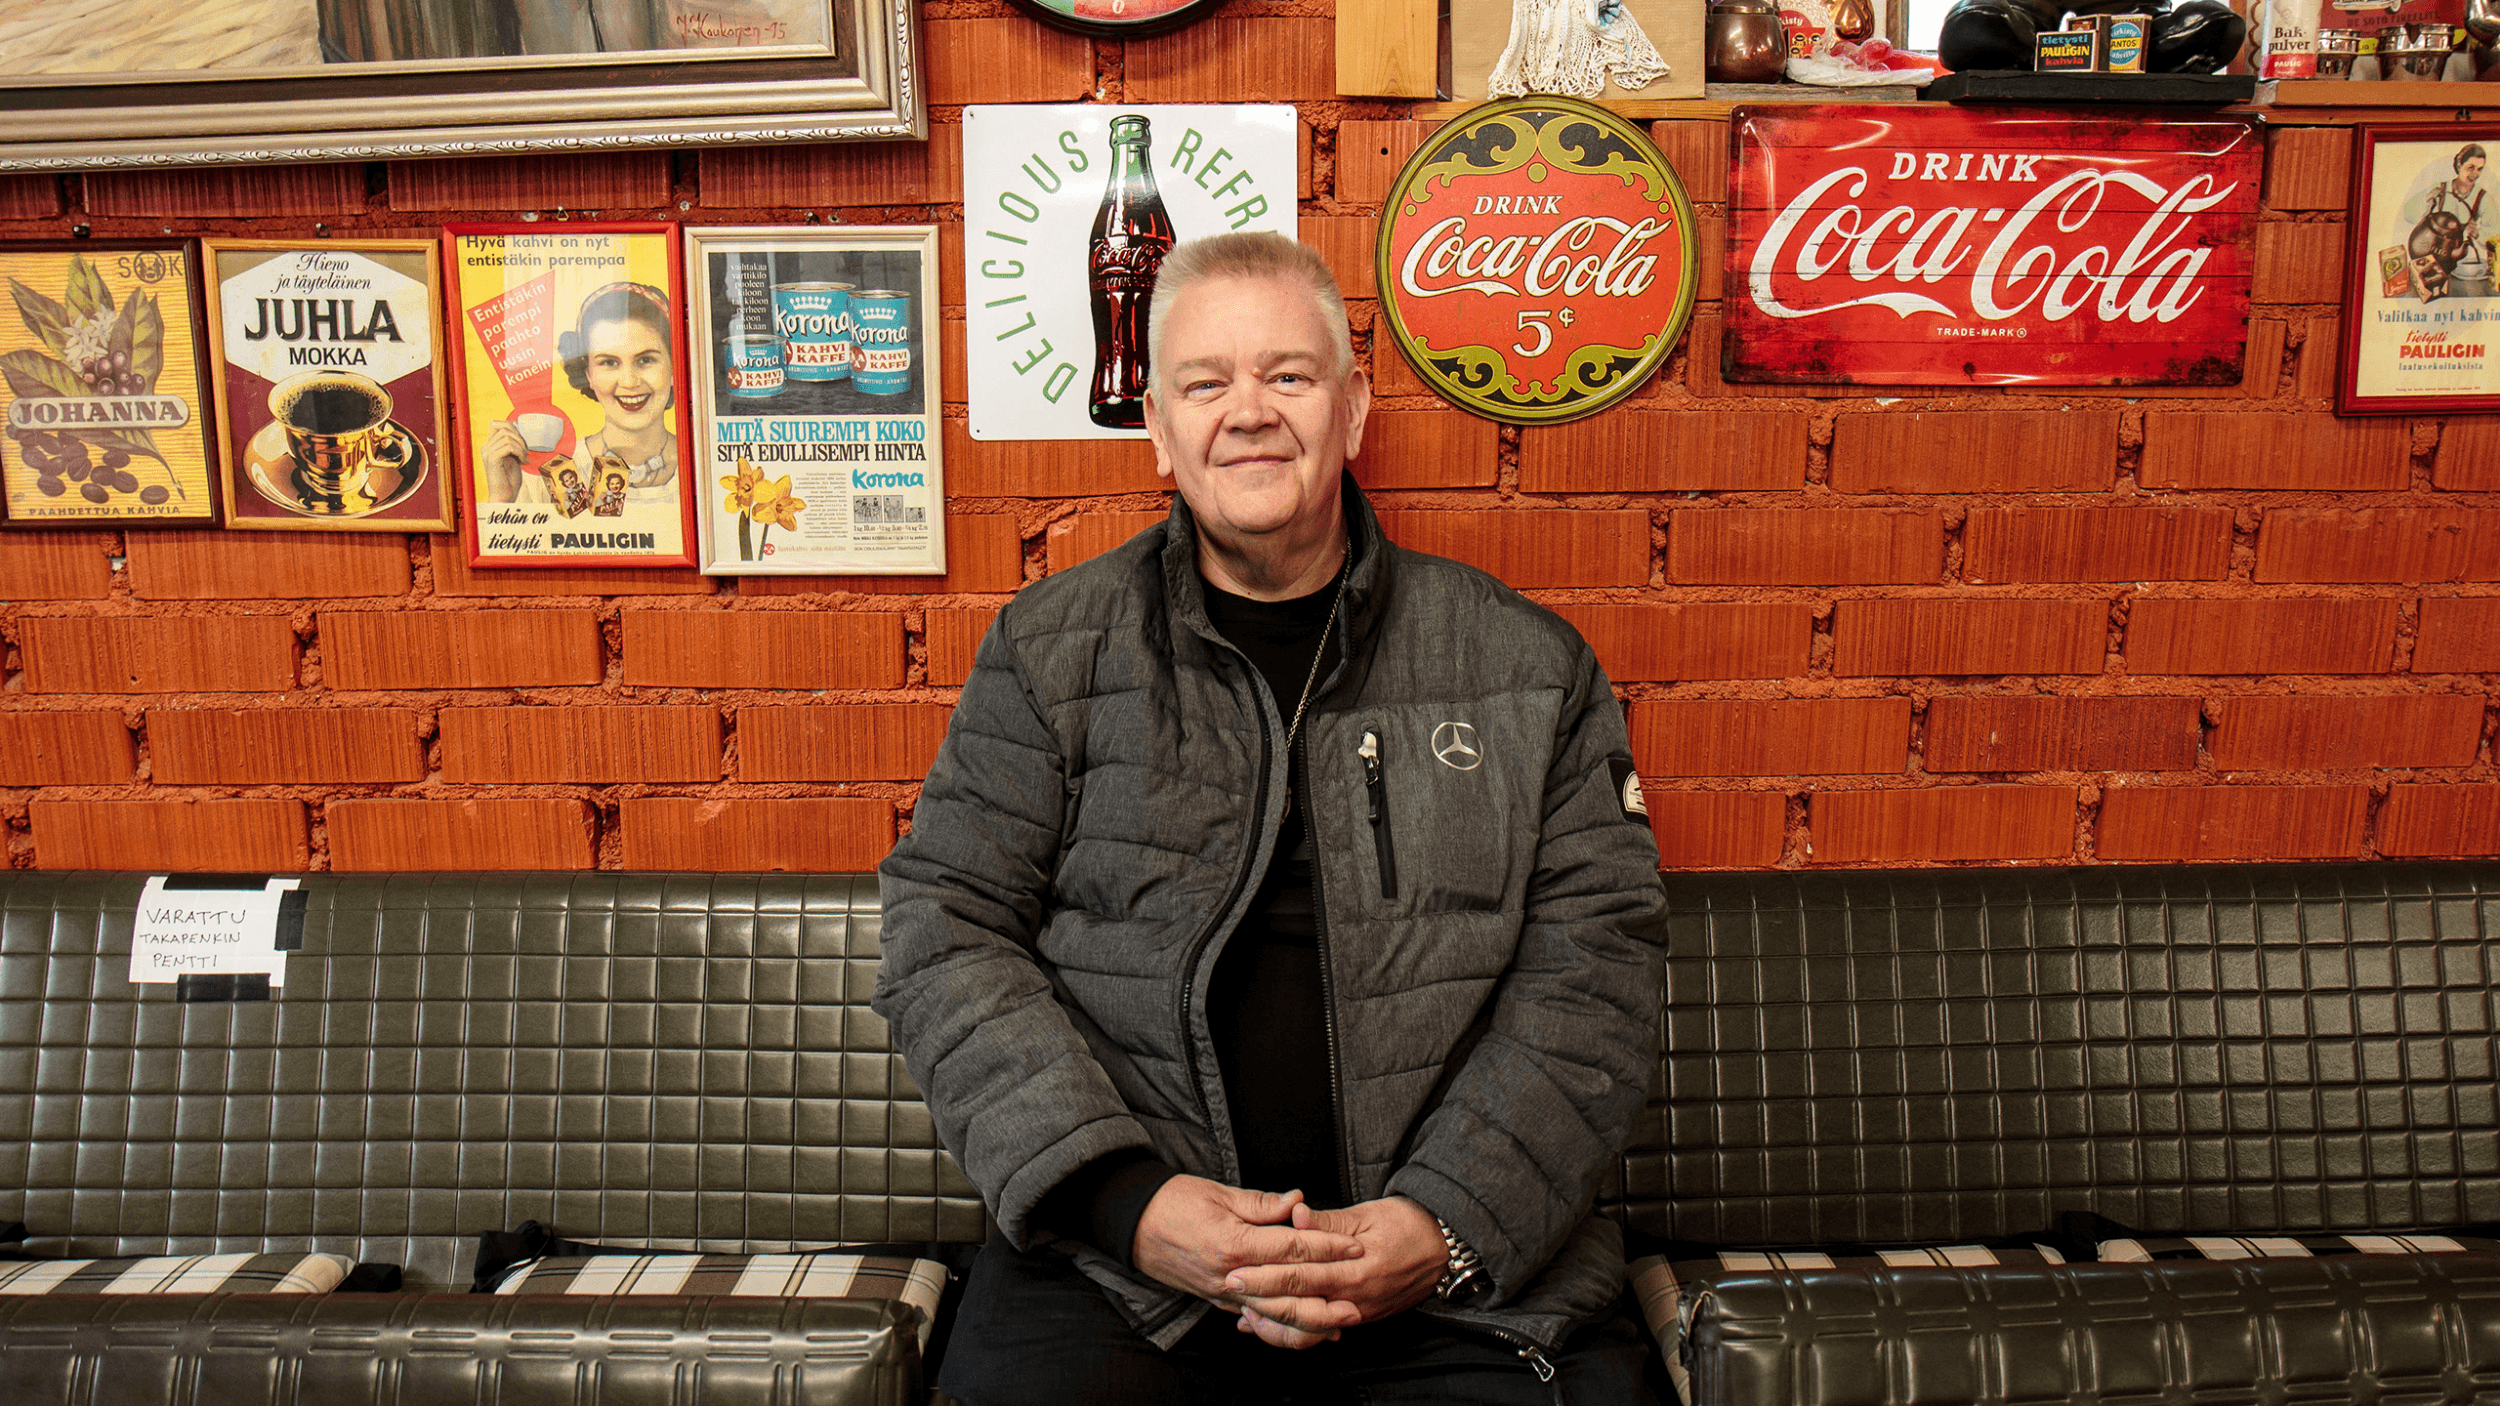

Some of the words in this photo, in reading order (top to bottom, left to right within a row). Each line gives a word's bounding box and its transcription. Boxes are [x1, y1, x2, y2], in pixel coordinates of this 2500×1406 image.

[2042, 34, 2088, 45] tietysti
[2268, 39, 2311, 55] pulver
[2040, 46, 2090, 57] PAULIGIN
[2045, 56, 2084, 66] kahvia
[1888, 152, 2042, 183] DRINK
[1170, 128, 1278, 234] REFR
[1472, 194, 1564, 216] DRINK
[466, 235, 506, 252] Hyvä
[512, 234, 553, 248] kahvi
[560, 238, 579, 248] on
[585, 236, 610, 251] nyt
[1748, 166, 2239, 323] Coca-Cola
[296, 251, 350, 272] Hieno
[467, 253, 542, 266] entistäkin
[549, 255, 625, 269] parempaa
[1400, 216, 1673, 298] Coca-Cola
[981, 130, 1088, 403] DELICIOUS
[270, 273, 290, 294] ja
[293, 272, 371, 294] täyteläinen
[473, 282, 547, 323] Entistäkin
[745, 297, 769, 305] kiloon
[244, 297, 406, 343] JUHLA
[483, 302, 542, 342] parempi
[2377, 310, 2428, 323] Valitkaa
[2434, 309, 2455, 325] nyt
[490, 325, 541, 358] paahto
[2405, 329, 2449, 345] tietysti
[289, 347, 368, 366] MOKKA
[796, 343, 846, 354] KAHVI
[870, 352, 907, 361] KAHVI
[2399, 344, 2486, 359] PAULIGIN
[499, 347, 536, 370] uusin
[796, 353, 846, 363] KAFFE
[870, 360, 908, 370] KAFFE
[2399, 362, 2484, 371] laatusekoituksista
[505, 359, 552, 386] konein
[746, 370, 782, 380] KAHVI
[746, 378, 782, 387] KAFFE
[16, 402, 185, 425] JOHANNA
[717, 418, 766, 443] MITÄ
[769, 420, 871, 442] SUUREMPI
[876, 420, 925, 442] KOKO
[717, 442, 755, 463] SITÄ
[758, 443, 870, 462] EDULLISEMPI
[874, 443, 927, 461] HINTA
[29, 507, 120, 516] PAAHDETTUA
[127, 506, 181, 515] KAHVIA
[532, 513, 550, 524] on
[488, 533, 543, 553] tietysti
[551, 532, 655, 549] PAULIGIN
[146, 908, 246, 926] VARATTU
[140, 932, 241, 944] TAKAPENKIN
[153, 953, 218, 968] PENTTI
